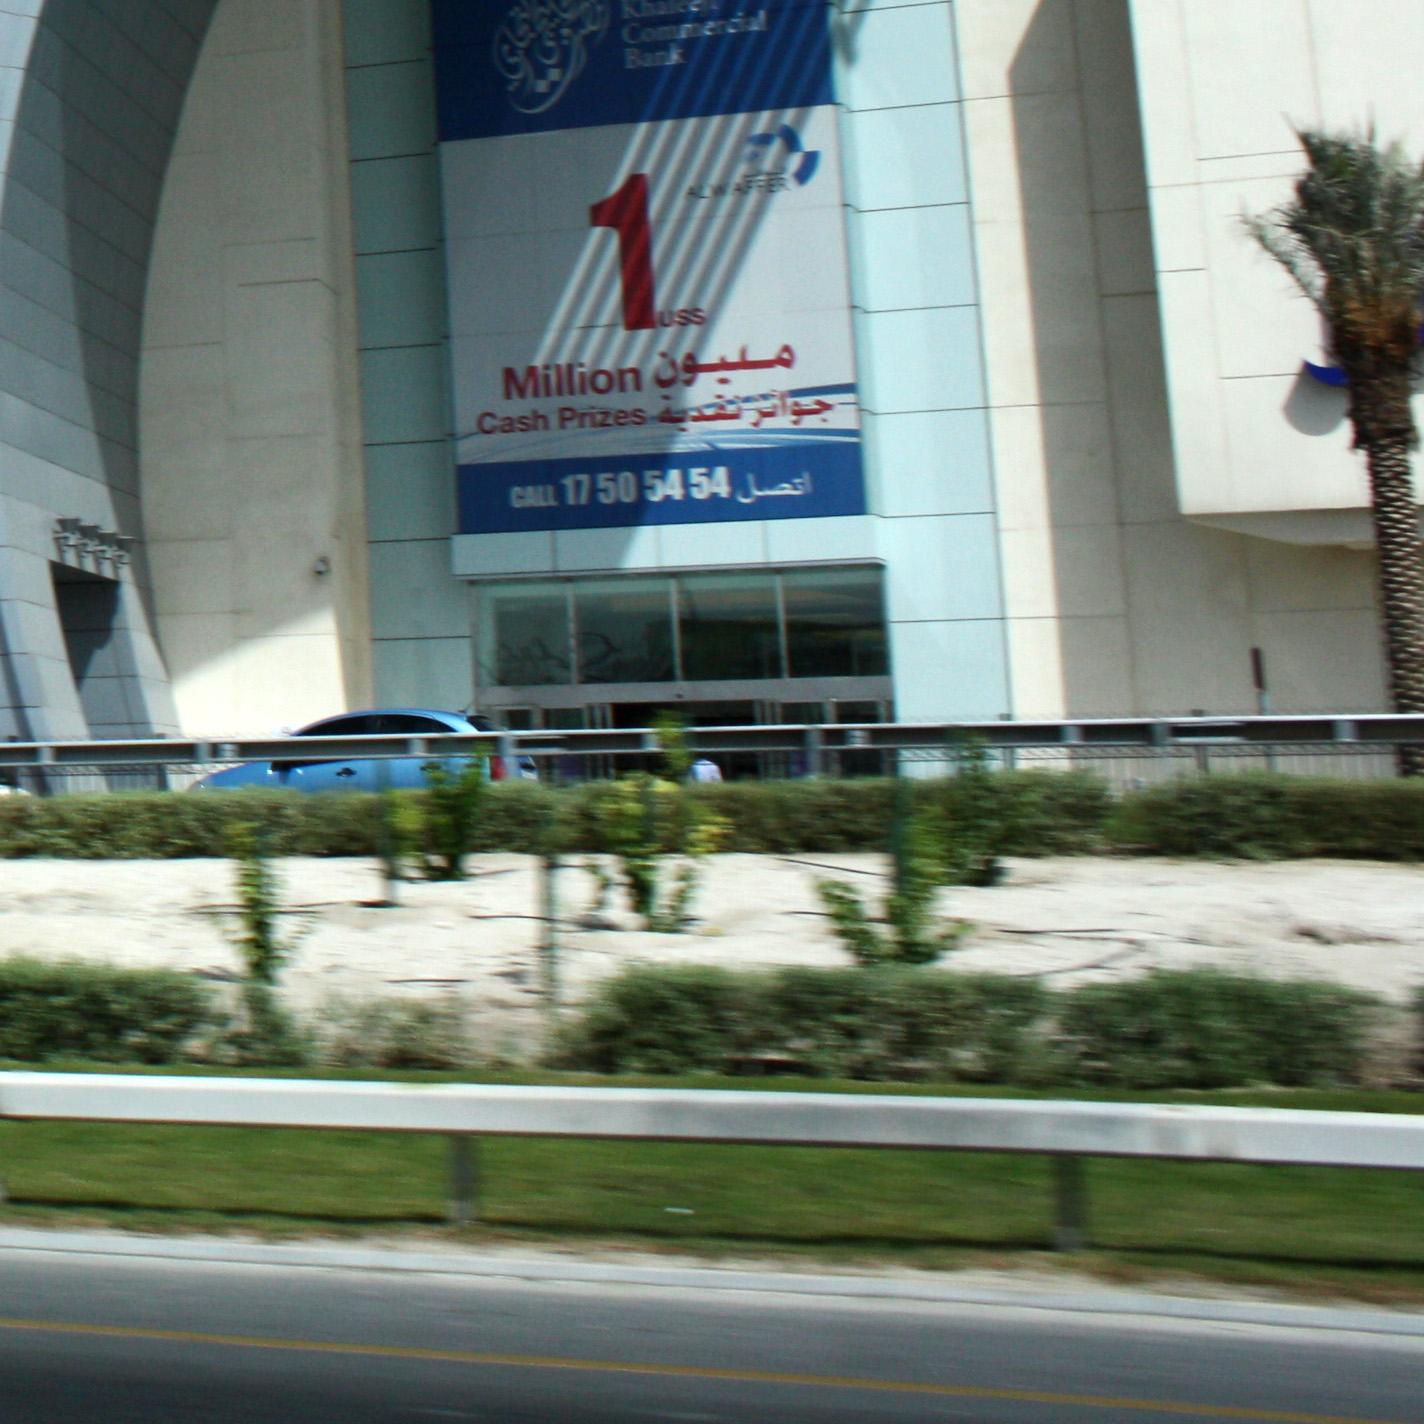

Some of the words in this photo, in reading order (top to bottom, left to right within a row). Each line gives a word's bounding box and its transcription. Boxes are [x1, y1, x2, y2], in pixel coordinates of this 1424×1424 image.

[622, 9, 770, 45] Commercial
[624, 42, 686, 69] Bank
[589, 173, 656, 331] 1
[502, 361, 643, 401] Million
[653, 343, 796, 389] مليون
[476, 410, 550, 435] Cash
[557, 406, 647, 430] Prizes
[510, 484, 559, 509] CALL
[562, 473, 592, 506] 17
[596, 471, 639, 505] 50
[644, 467, 685, 502] 54
[688, 465, 731, 499] 54
[735, 471, 814, 504] اتصل
